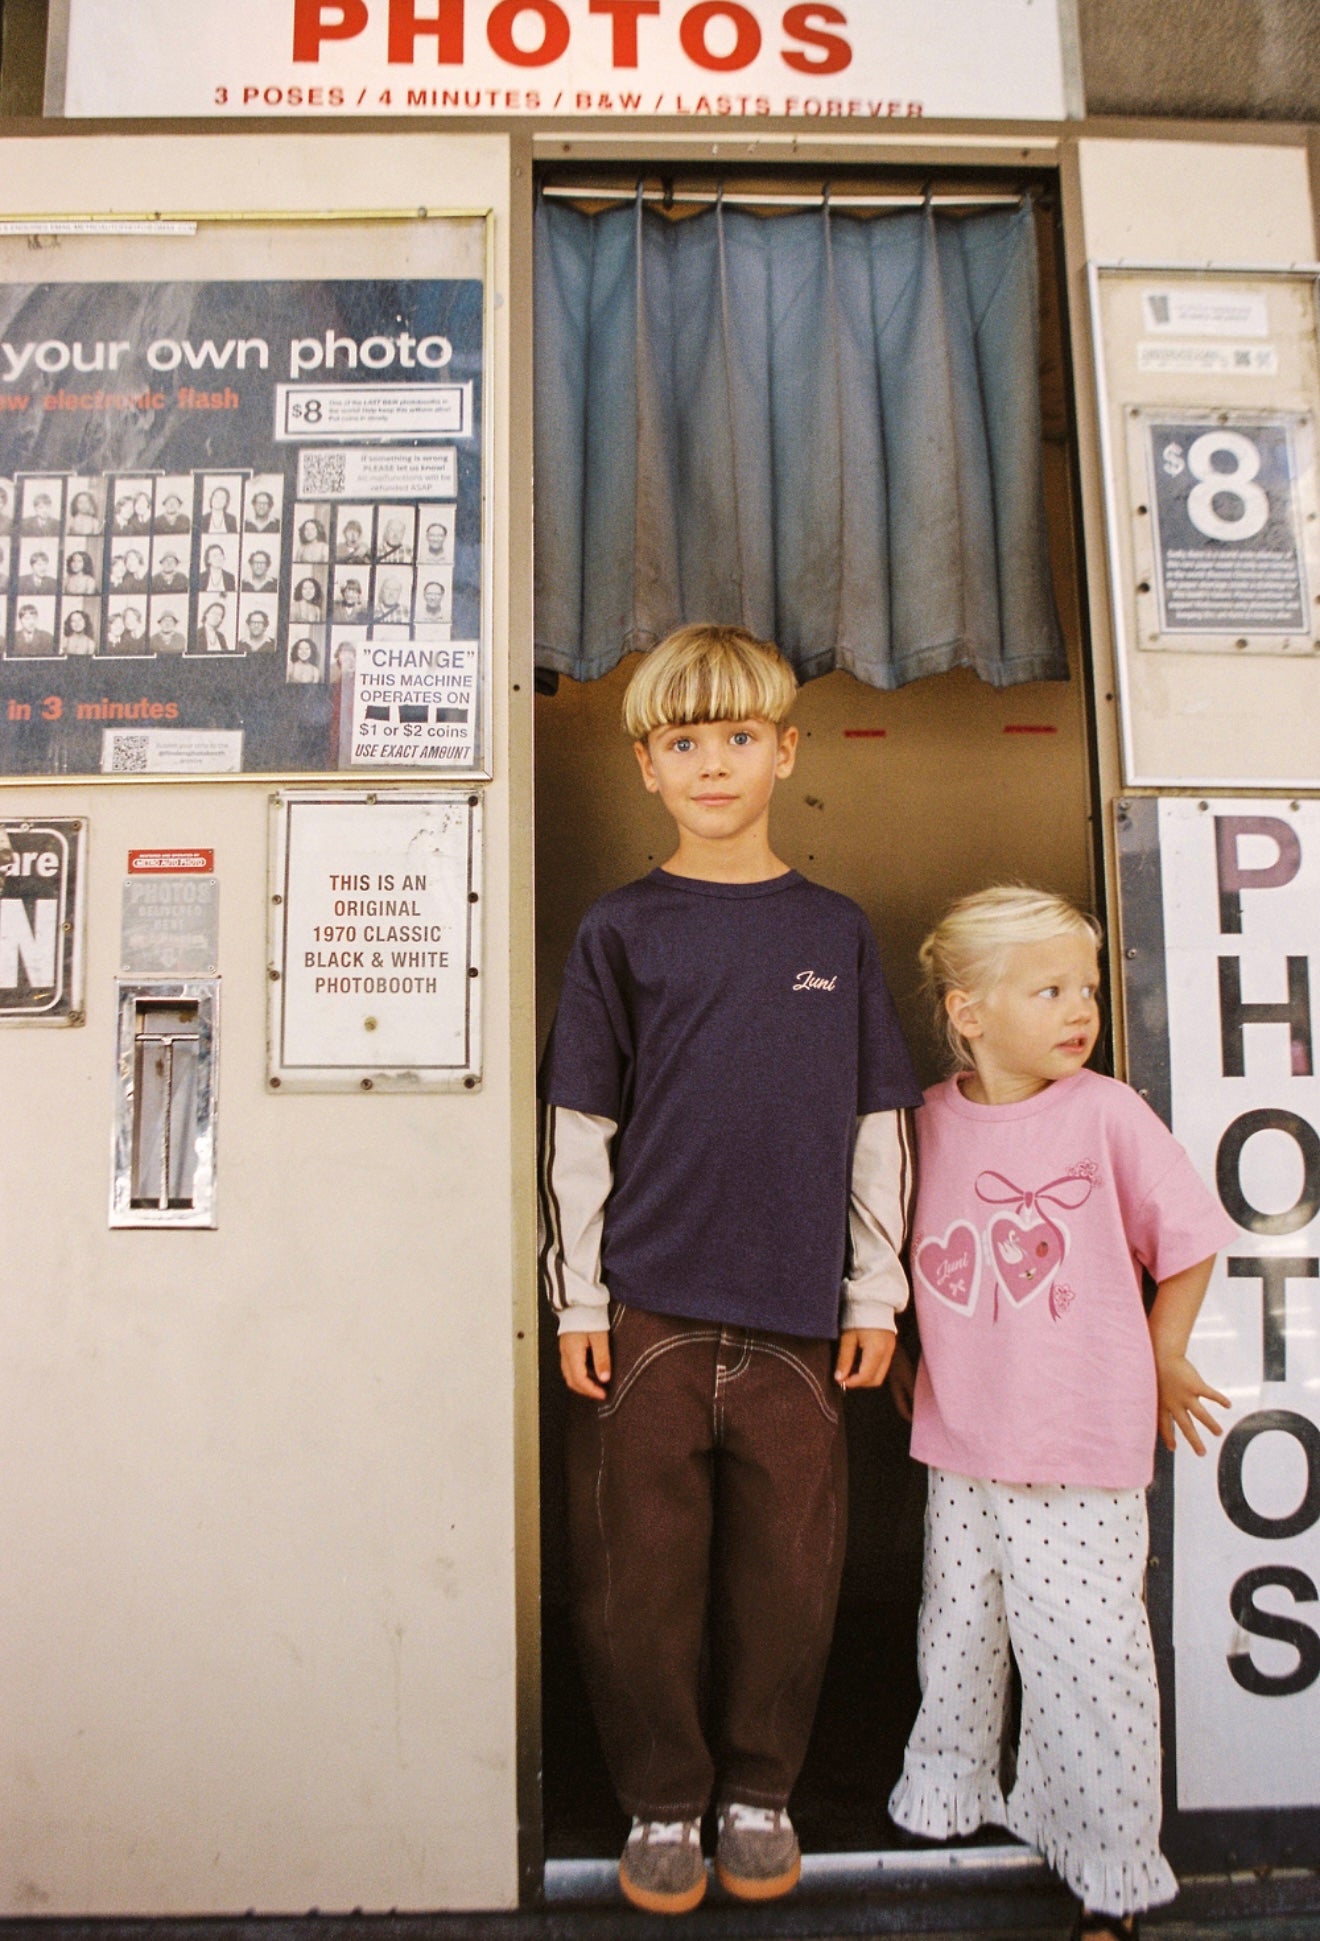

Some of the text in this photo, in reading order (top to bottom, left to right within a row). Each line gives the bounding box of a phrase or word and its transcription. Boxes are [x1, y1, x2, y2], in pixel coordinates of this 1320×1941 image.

[292, 0, 853, 76] PHOTOS
[214, 87, 228, 105] 3
[243, 87, 345, 106] POSES
[379, 88, 392, 106] 4
[407, 88, 541, 108] MINUTES
[575, 92, 642, 110] B&W
[676, 93, 771, 115] LASTS
[785, 95, 924, 117] FOREVER
[2, 330, 453, 381] your own photo
[43, 388, 166, 411] electronic
[178, 386, 240, 410] flash
[291, 400, 323, 424] $8
[1162, 430, 1270, 541] $8
[363, 648, 475, 669] "CHANGE"
[360, 674, 473, 688] THIS MACHINE
[360, 690, 470, 704] OPERATES ON
[8, 695, 179, 721] in 3 minutes
[359, 722, 468, 738] $1 or $2 coins
[355, 743, 471, 760] USE EXACT AMOUNT
[329, 875, 427, 891] THIS IS AN
[334, 900, 421, 917] ORIGINAL
[313, 925, 442, 942] 1970 CLASSIC
[304, 951, 449, 968] BLACK & WHITE
[315, 977, 437, 994] PHOTOBOOTH
[1214, 815, 1320, 1697] PHOTOS
